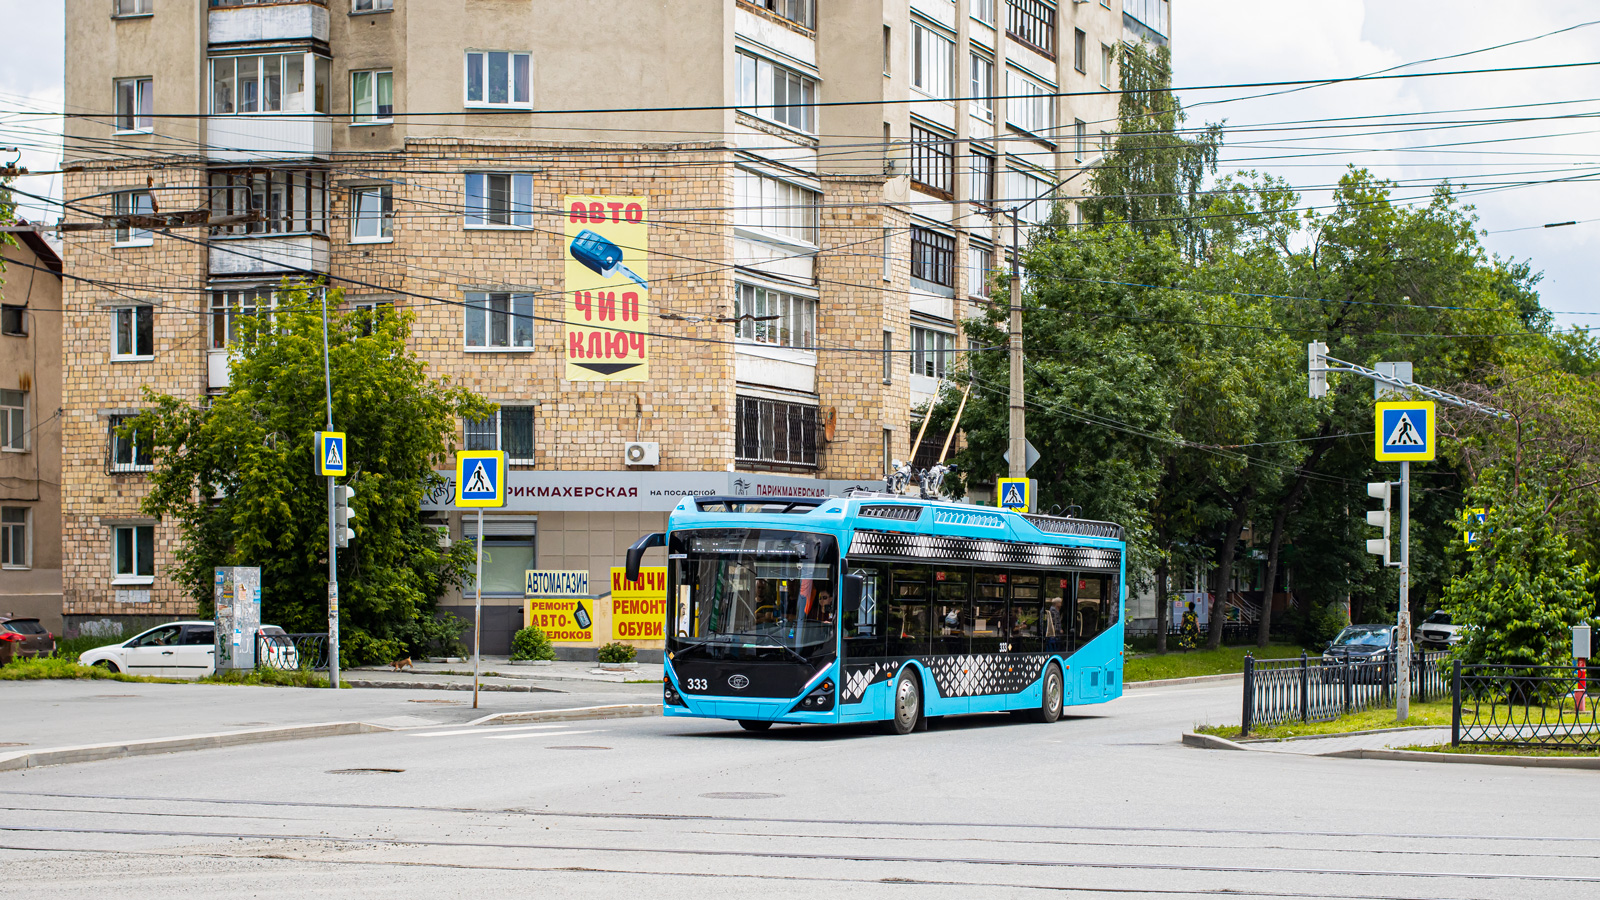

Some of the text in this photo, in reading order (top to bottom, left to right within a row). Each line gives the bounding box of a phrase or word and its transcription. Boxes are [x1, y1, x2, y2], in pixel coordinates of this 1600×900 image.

[569, 201, 643, 225] АВТО
[575, 290, 639, 322] ЧИП
[569, 331, 645, 359] КЛЮЧ
[756, 483, 825, 498] ПАРИКМАХЕРСКАЯ
[527, 572, 588, 594] АВТОМАГАЗИН
[613, 572, 665, 591] КЛЮЧИ
[532, 602, 575, 610] РЕМОНТ
[613, 600, 667, 615] РЕМОНТ
[531, 614, 571, 627] АВТО-
[537, 630, 592, 640] ЕЛОКОВ
[618, 621, 662, 637] ОБУВИ
[999, 642, 1008, 653] 333
[687, 678, 708, 690] 333
